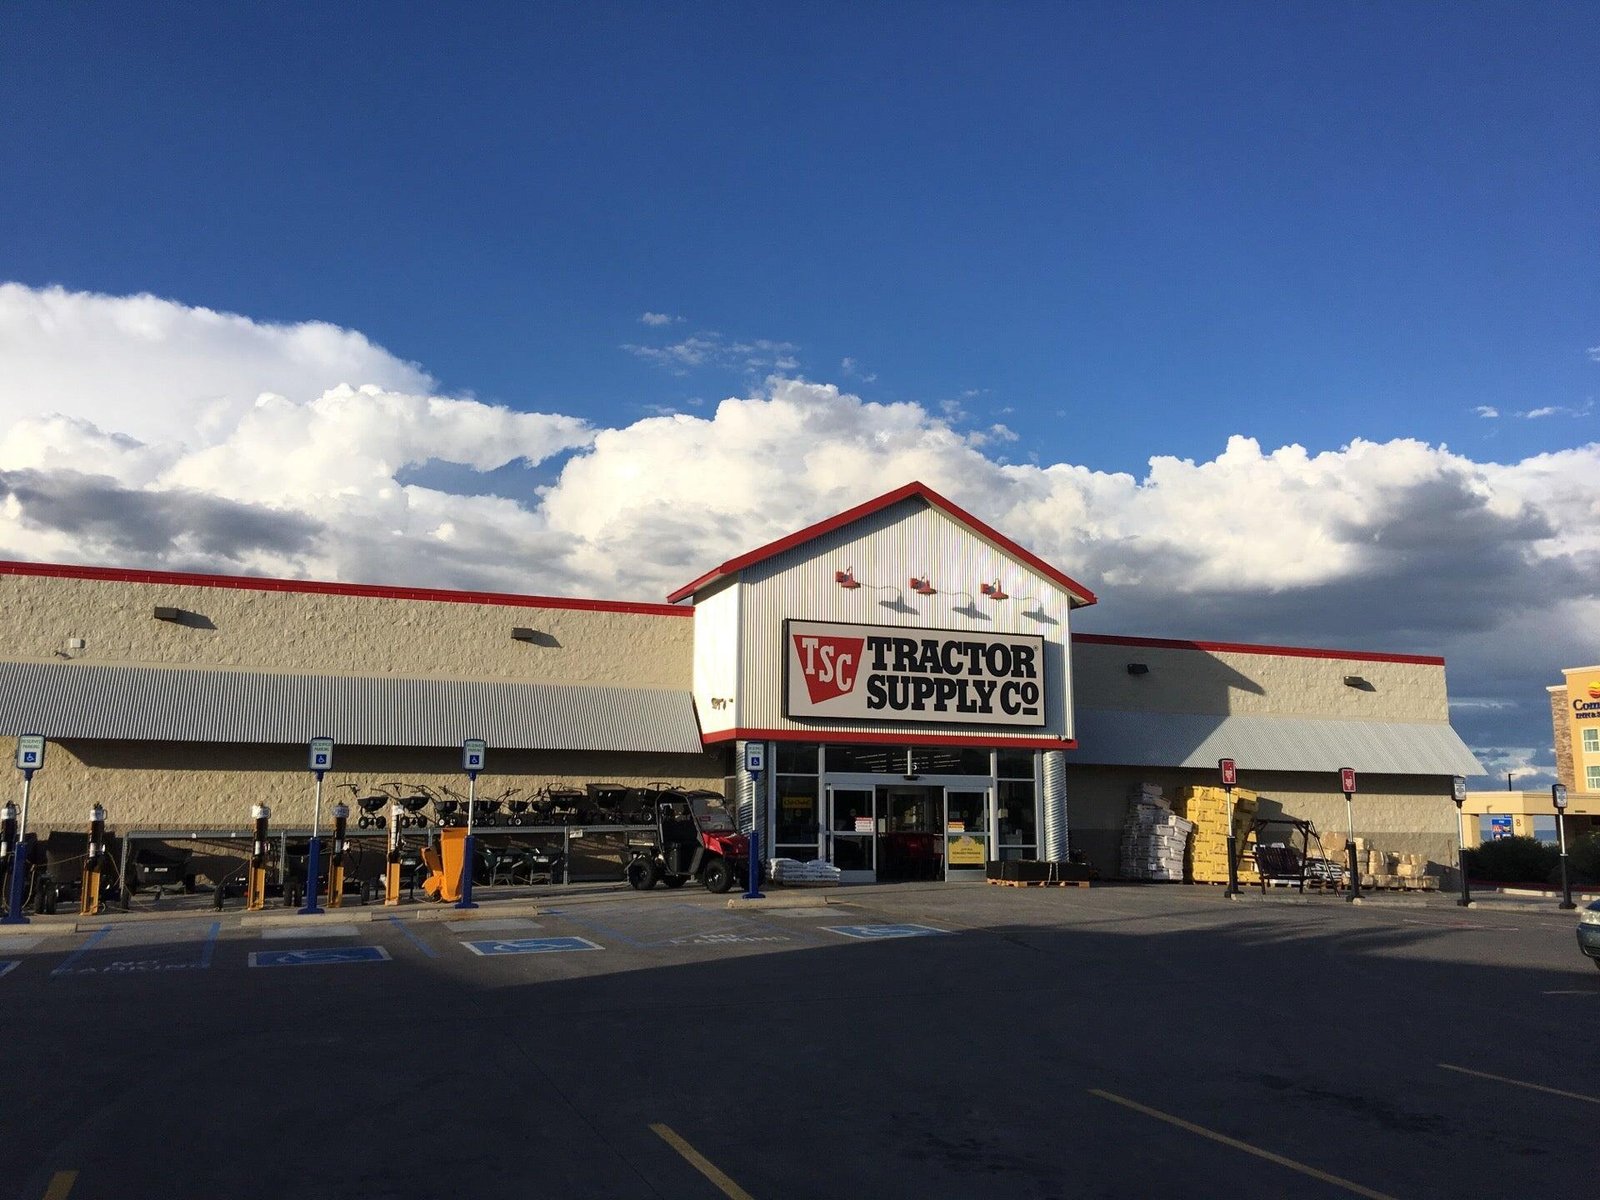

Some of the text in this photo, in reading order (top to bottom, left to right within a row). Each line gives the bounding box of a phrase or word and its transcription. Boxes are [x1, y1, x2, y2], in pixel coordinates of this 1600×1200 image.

[802, 637, 852, 692] TSC
[867, 636, 1036, 678] TRACTOR
[867, 675, 997, 714] SUPPLY
